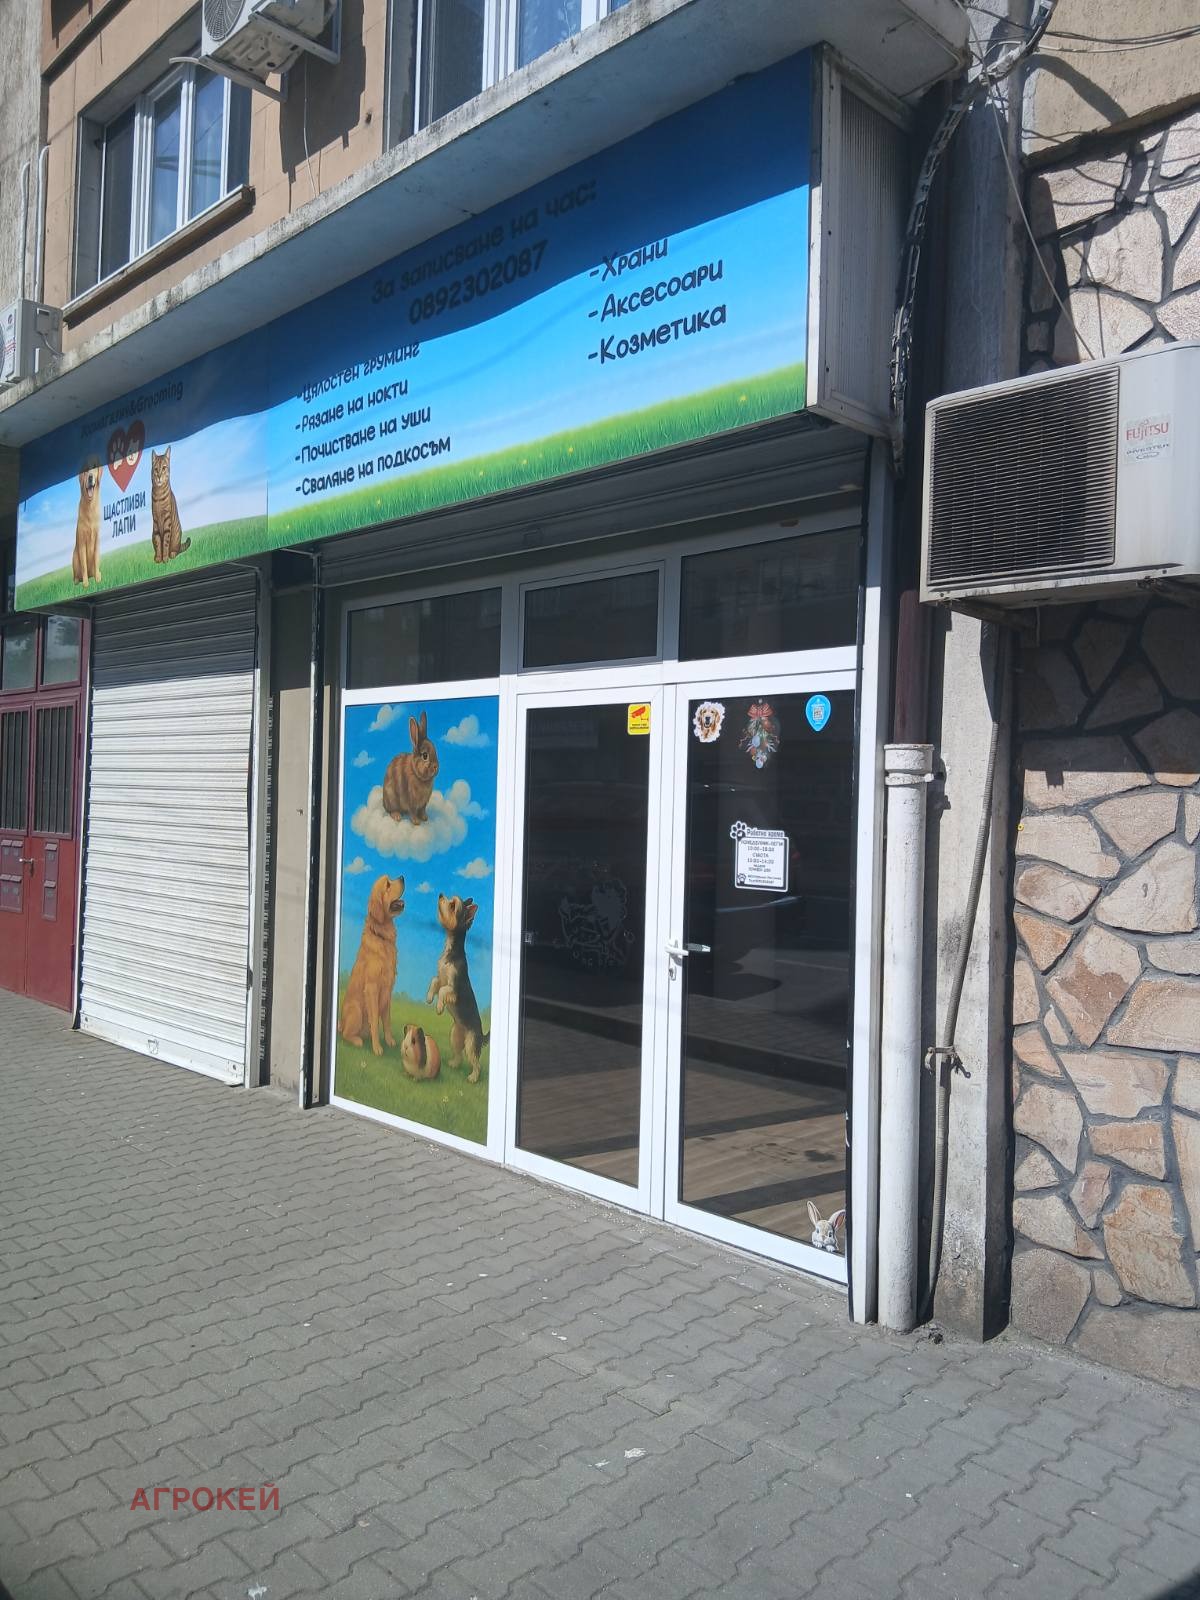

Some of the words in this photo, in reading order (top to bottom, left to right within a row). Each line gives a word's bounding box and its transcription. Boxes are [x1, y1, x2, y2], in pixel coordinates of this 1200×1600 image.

[371, 279, 395, 304] За
[400, 225, 505, 291] записване
[511, 208, 539, 239] на
[545, 180, 598, 218] час:
[409, 239, 549, 325] 0892302087
[588, 259, 723, 322] -Аксесоари
[588, 304, 727, 364] -Козметика
[363, 341, 420, 376] груминг
[347, 396, 364, 416] на
[368, 379, 408, 407] нокти
[380, 418, 397, 437] на
[401, 406, 431, 429] уши
[358, 460, 374, 479] на
[377, 436, 451, 472] подкосъм
[103, 490, 146, 521] ЩАСТЛИВИ
[112, 513, 136, 538] ЛАПИ
